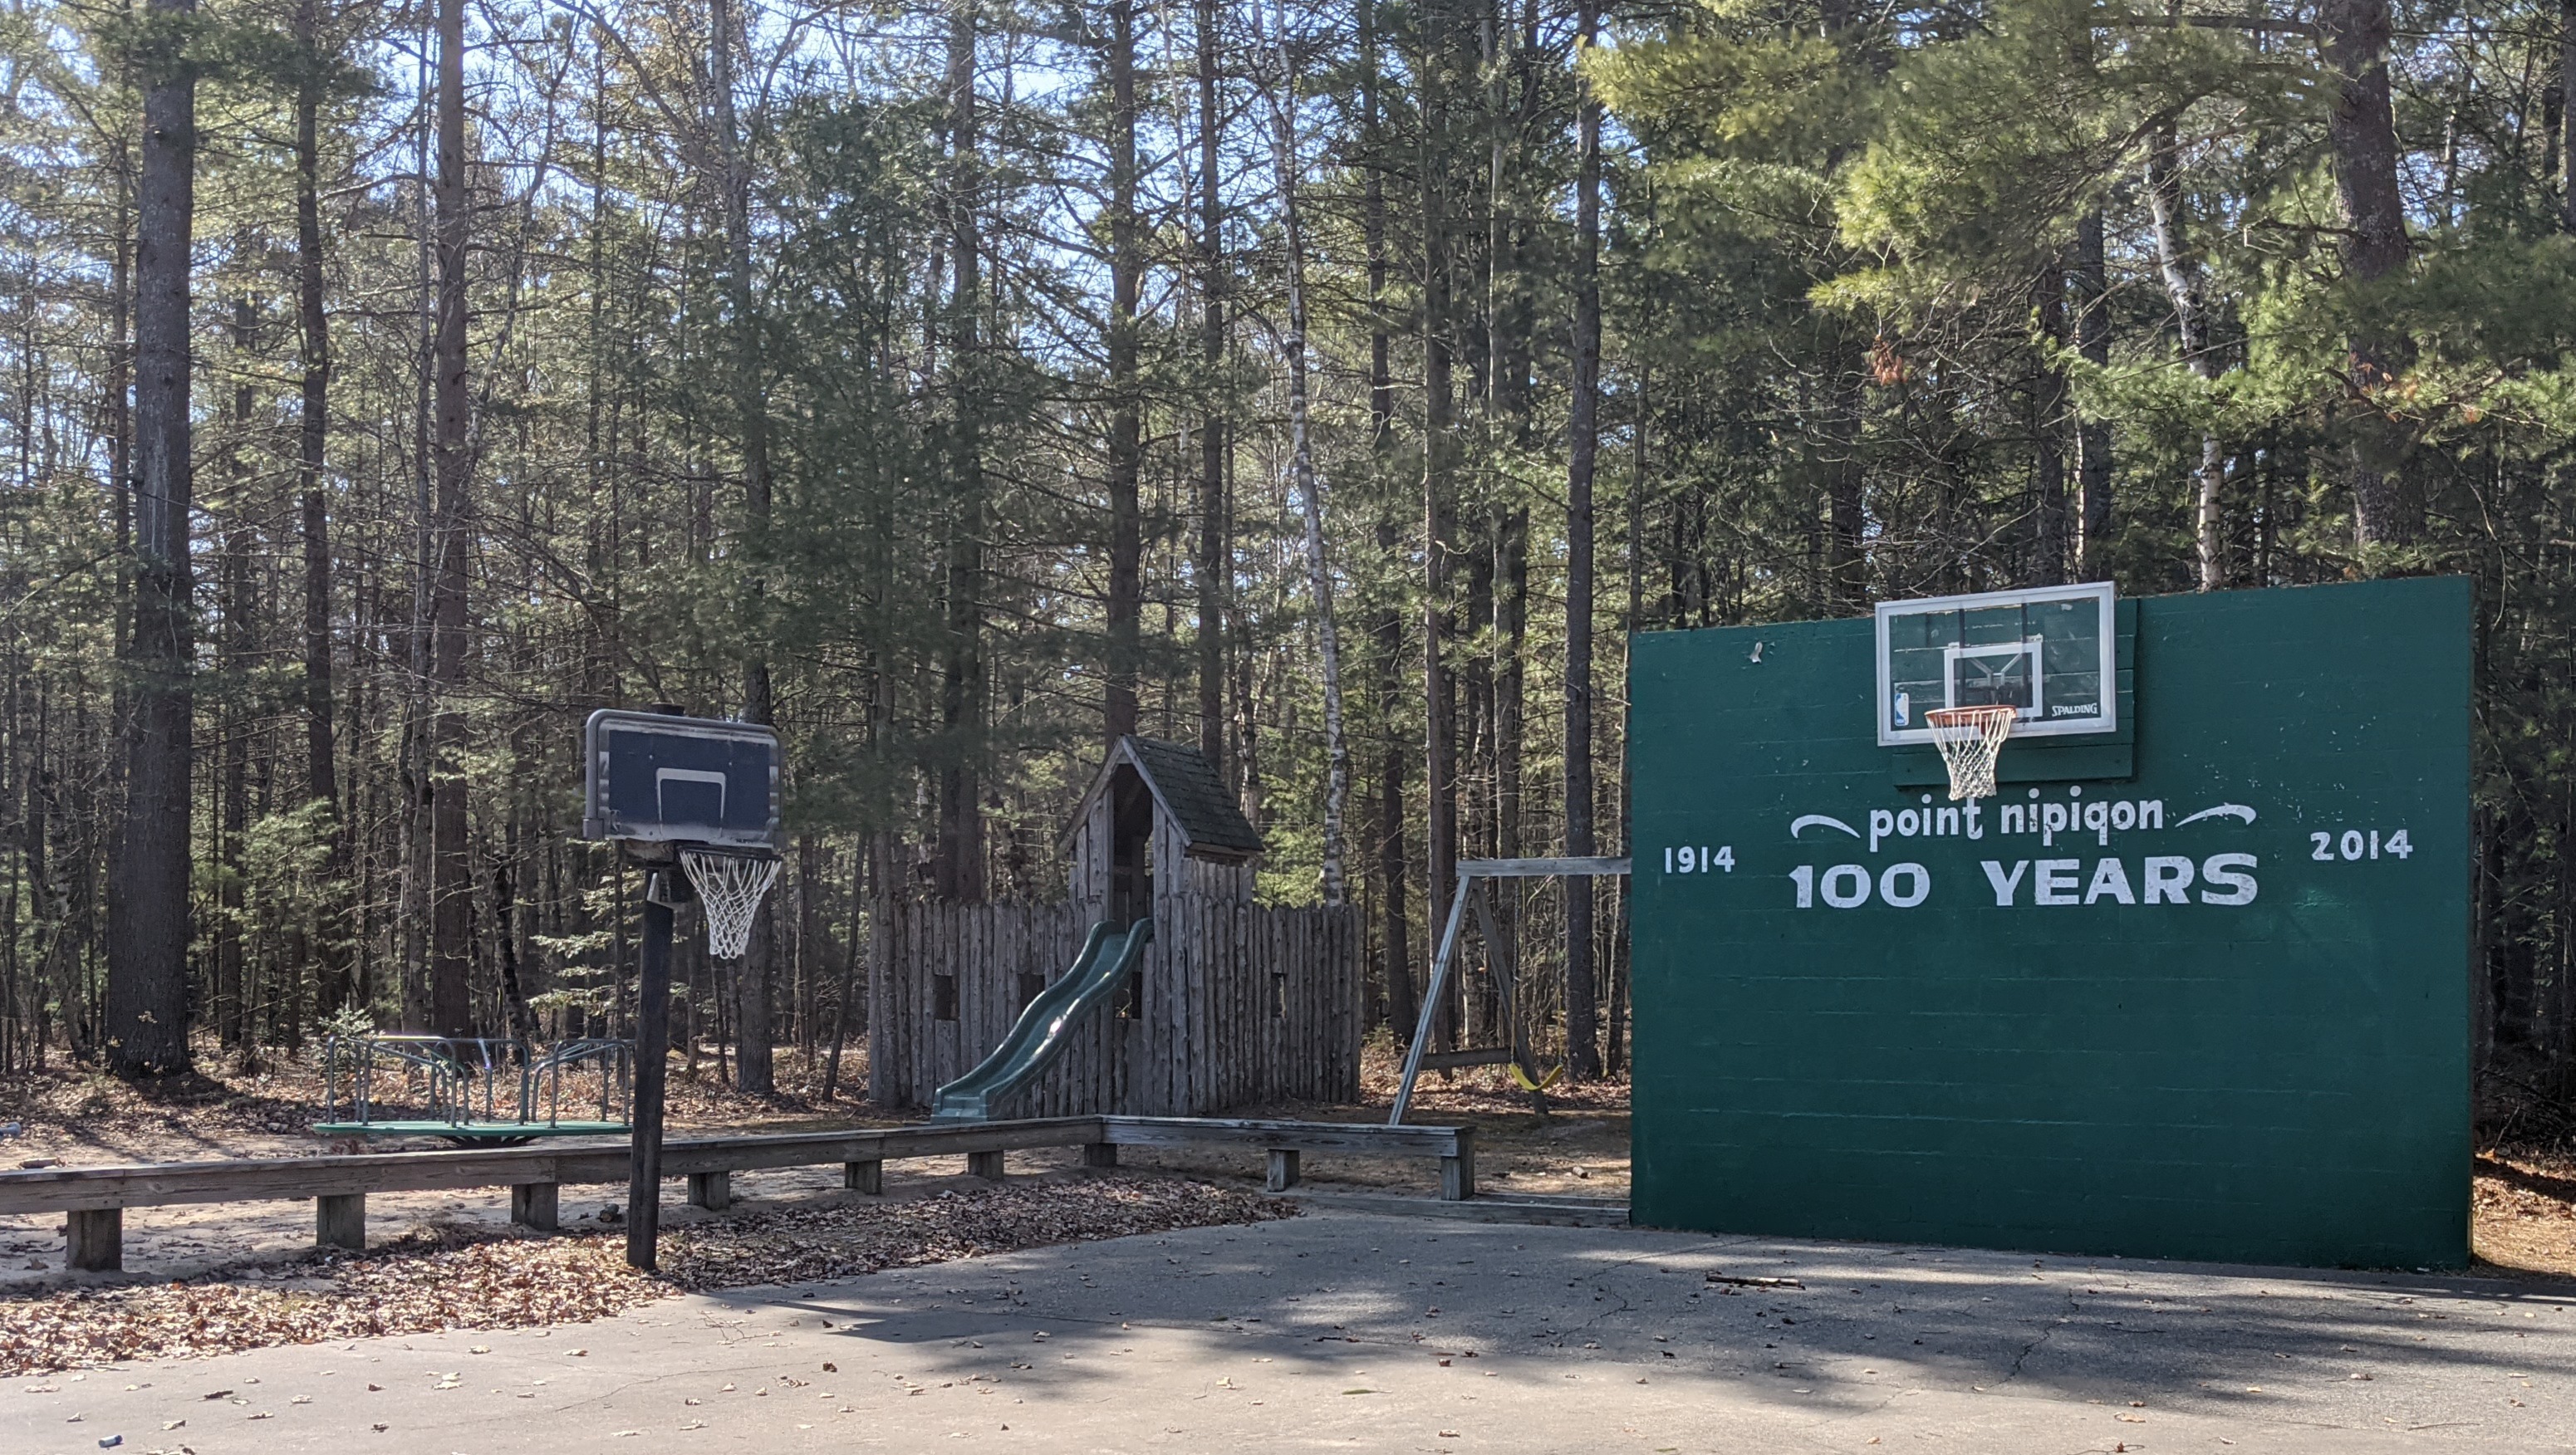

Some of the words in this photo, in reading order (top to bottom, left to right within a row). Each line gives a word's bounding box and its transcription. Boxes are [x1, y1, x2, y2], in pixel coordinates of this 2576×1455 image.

[2052, 703, 2098, 717] SPALDING
[1869, 793, 1983, 852] point
[1665, 845, 1735, 874] 1914
[2310, 830, 2413, 860] 2014
[1788, 862, 1931, 909] 100
[1980, 852, 2258, 906] YEARS
